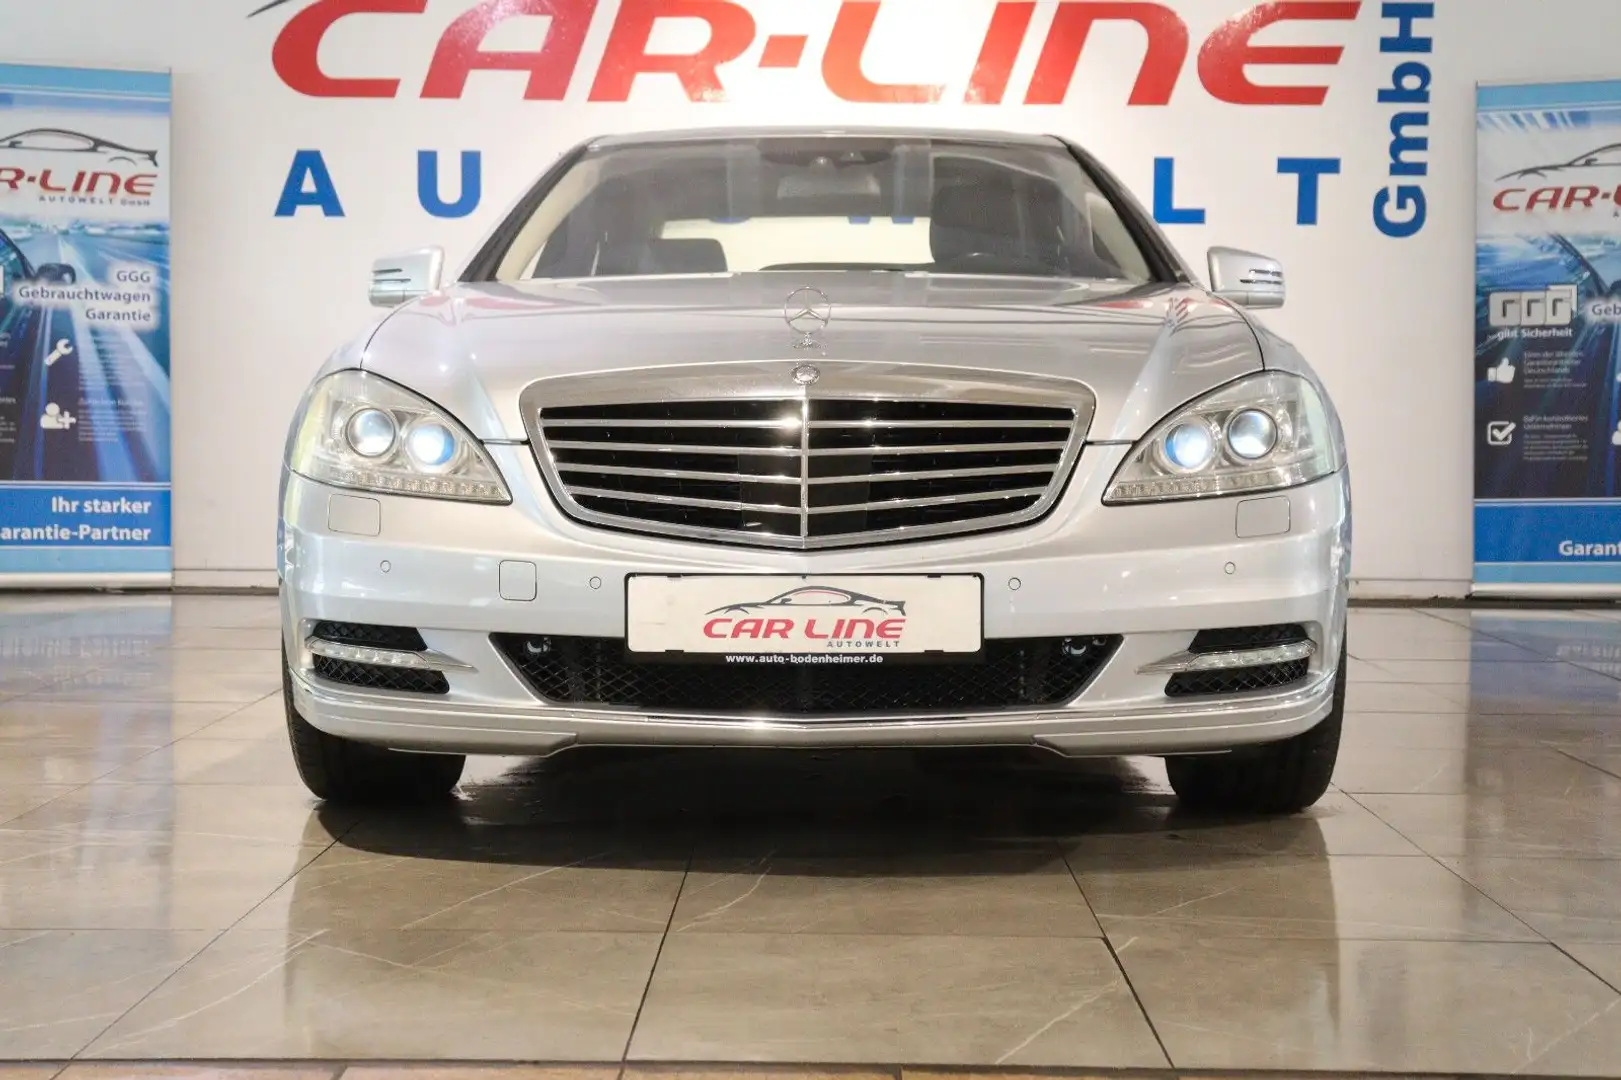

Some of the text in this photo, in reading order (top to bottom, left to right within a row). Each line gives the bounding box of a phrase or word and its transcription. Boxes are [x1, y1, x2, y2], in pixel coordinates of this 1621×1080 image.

[271, 0, 1362, 106] CAR-LINE
[1373, 2, 1434, 238] GmbH
[39, 195, 114, 205] AUTOWELT
[116, 270, 151, 283] GGG
[18, 286, 151, 305] Gebrauchtwagen
[85, 308, 151, 322] Garantie
[1520, 327, 1573, 338] Sicherheit
[51, 495, 152, 514] Ihr starker
[703, 618, 907, 639] CAR LINE
[826, 640, 901, 648] AUTOWELT
[725, 652, 884, 664] www.auto-bodenheimer.de
